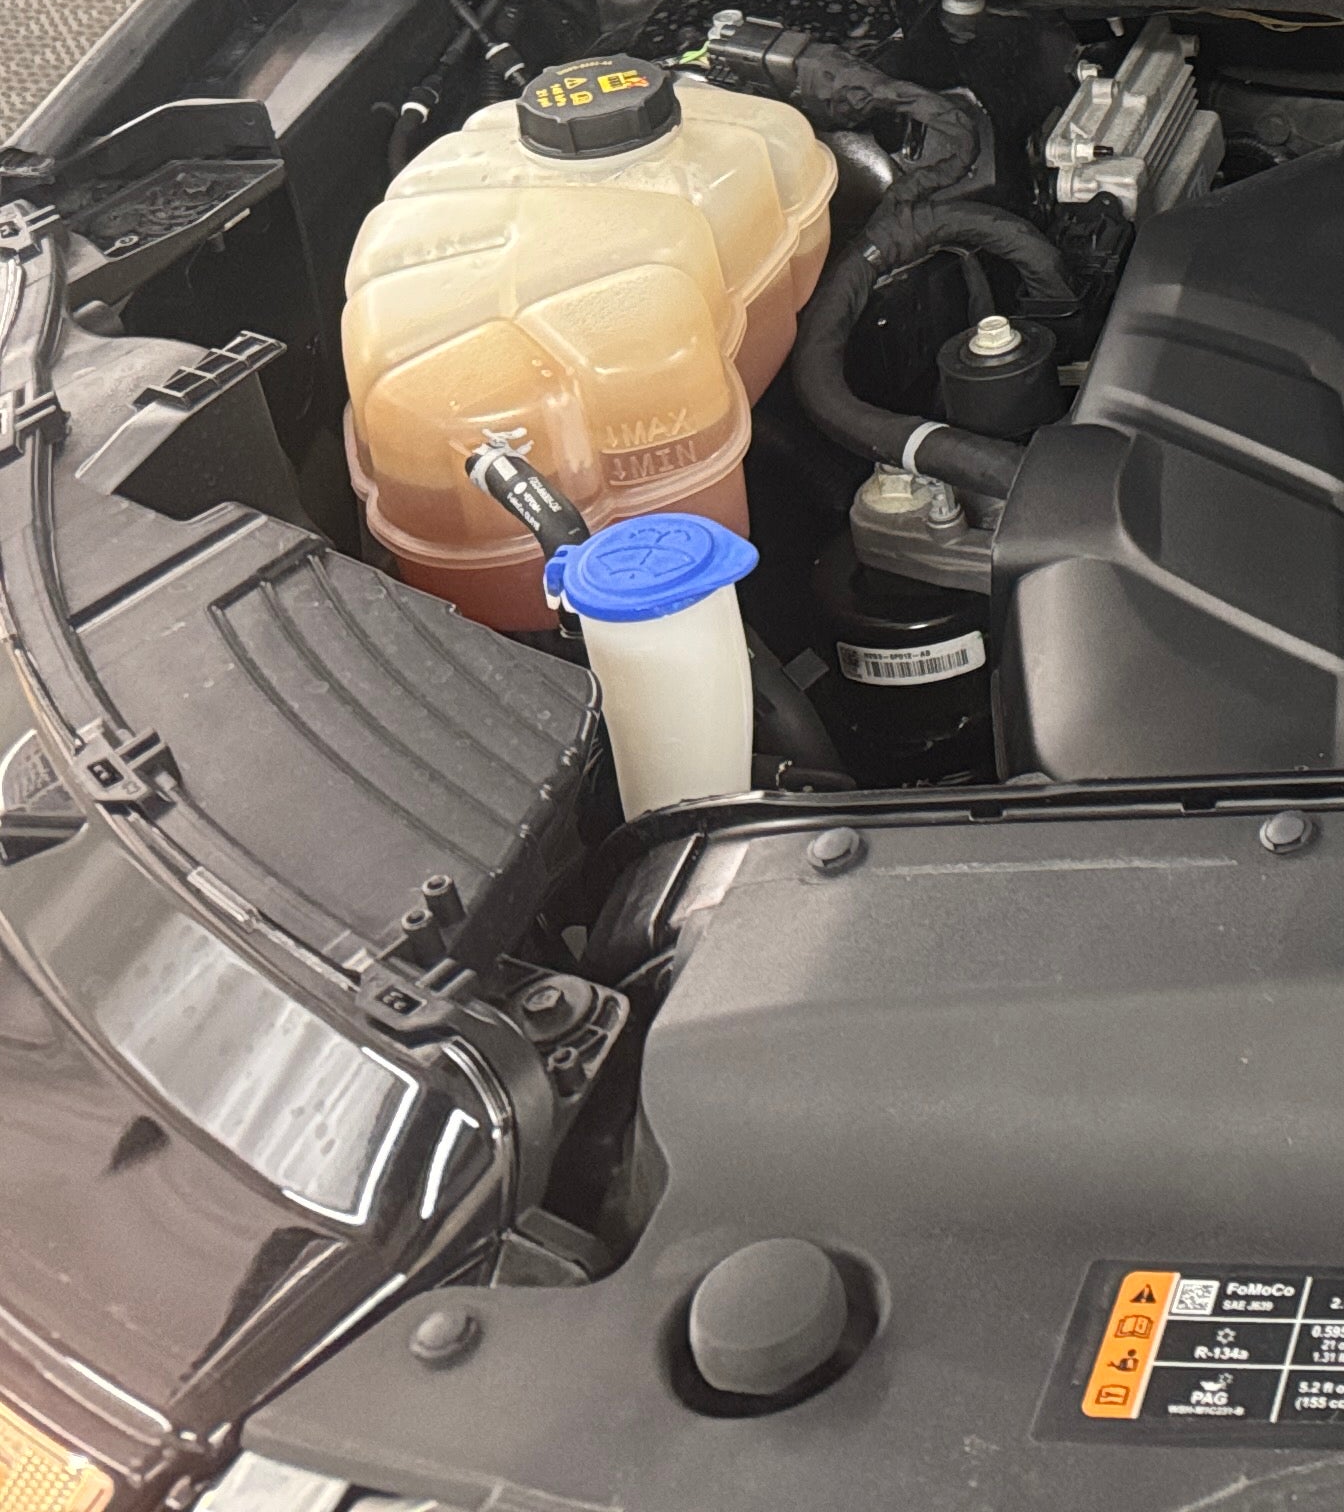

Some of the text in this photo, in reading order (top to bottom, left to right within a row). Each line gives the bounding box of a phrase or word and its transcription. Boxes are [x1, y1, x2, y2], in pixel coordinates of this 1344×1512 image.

[620, 408, 690, 447] MAX
[630, 440, 697, 479] MIN
[1226, 1282, 1296, 1297] FoMoCo
[1221, 1300, 1247, 1311] SAE
[1193, 1345, 1250, 1361] R-134a
[1320, 1340, 1336, 1351] 21
[1312, 1351, 1336, 1363] 1.31
[1298, 1381, 1321, 1394] 5.2
[1322, 1381, 1334, 1394] fl
[1189, 1390, 1230, 1406] PAG
[1294, 1396, 1328, 1412] (155
